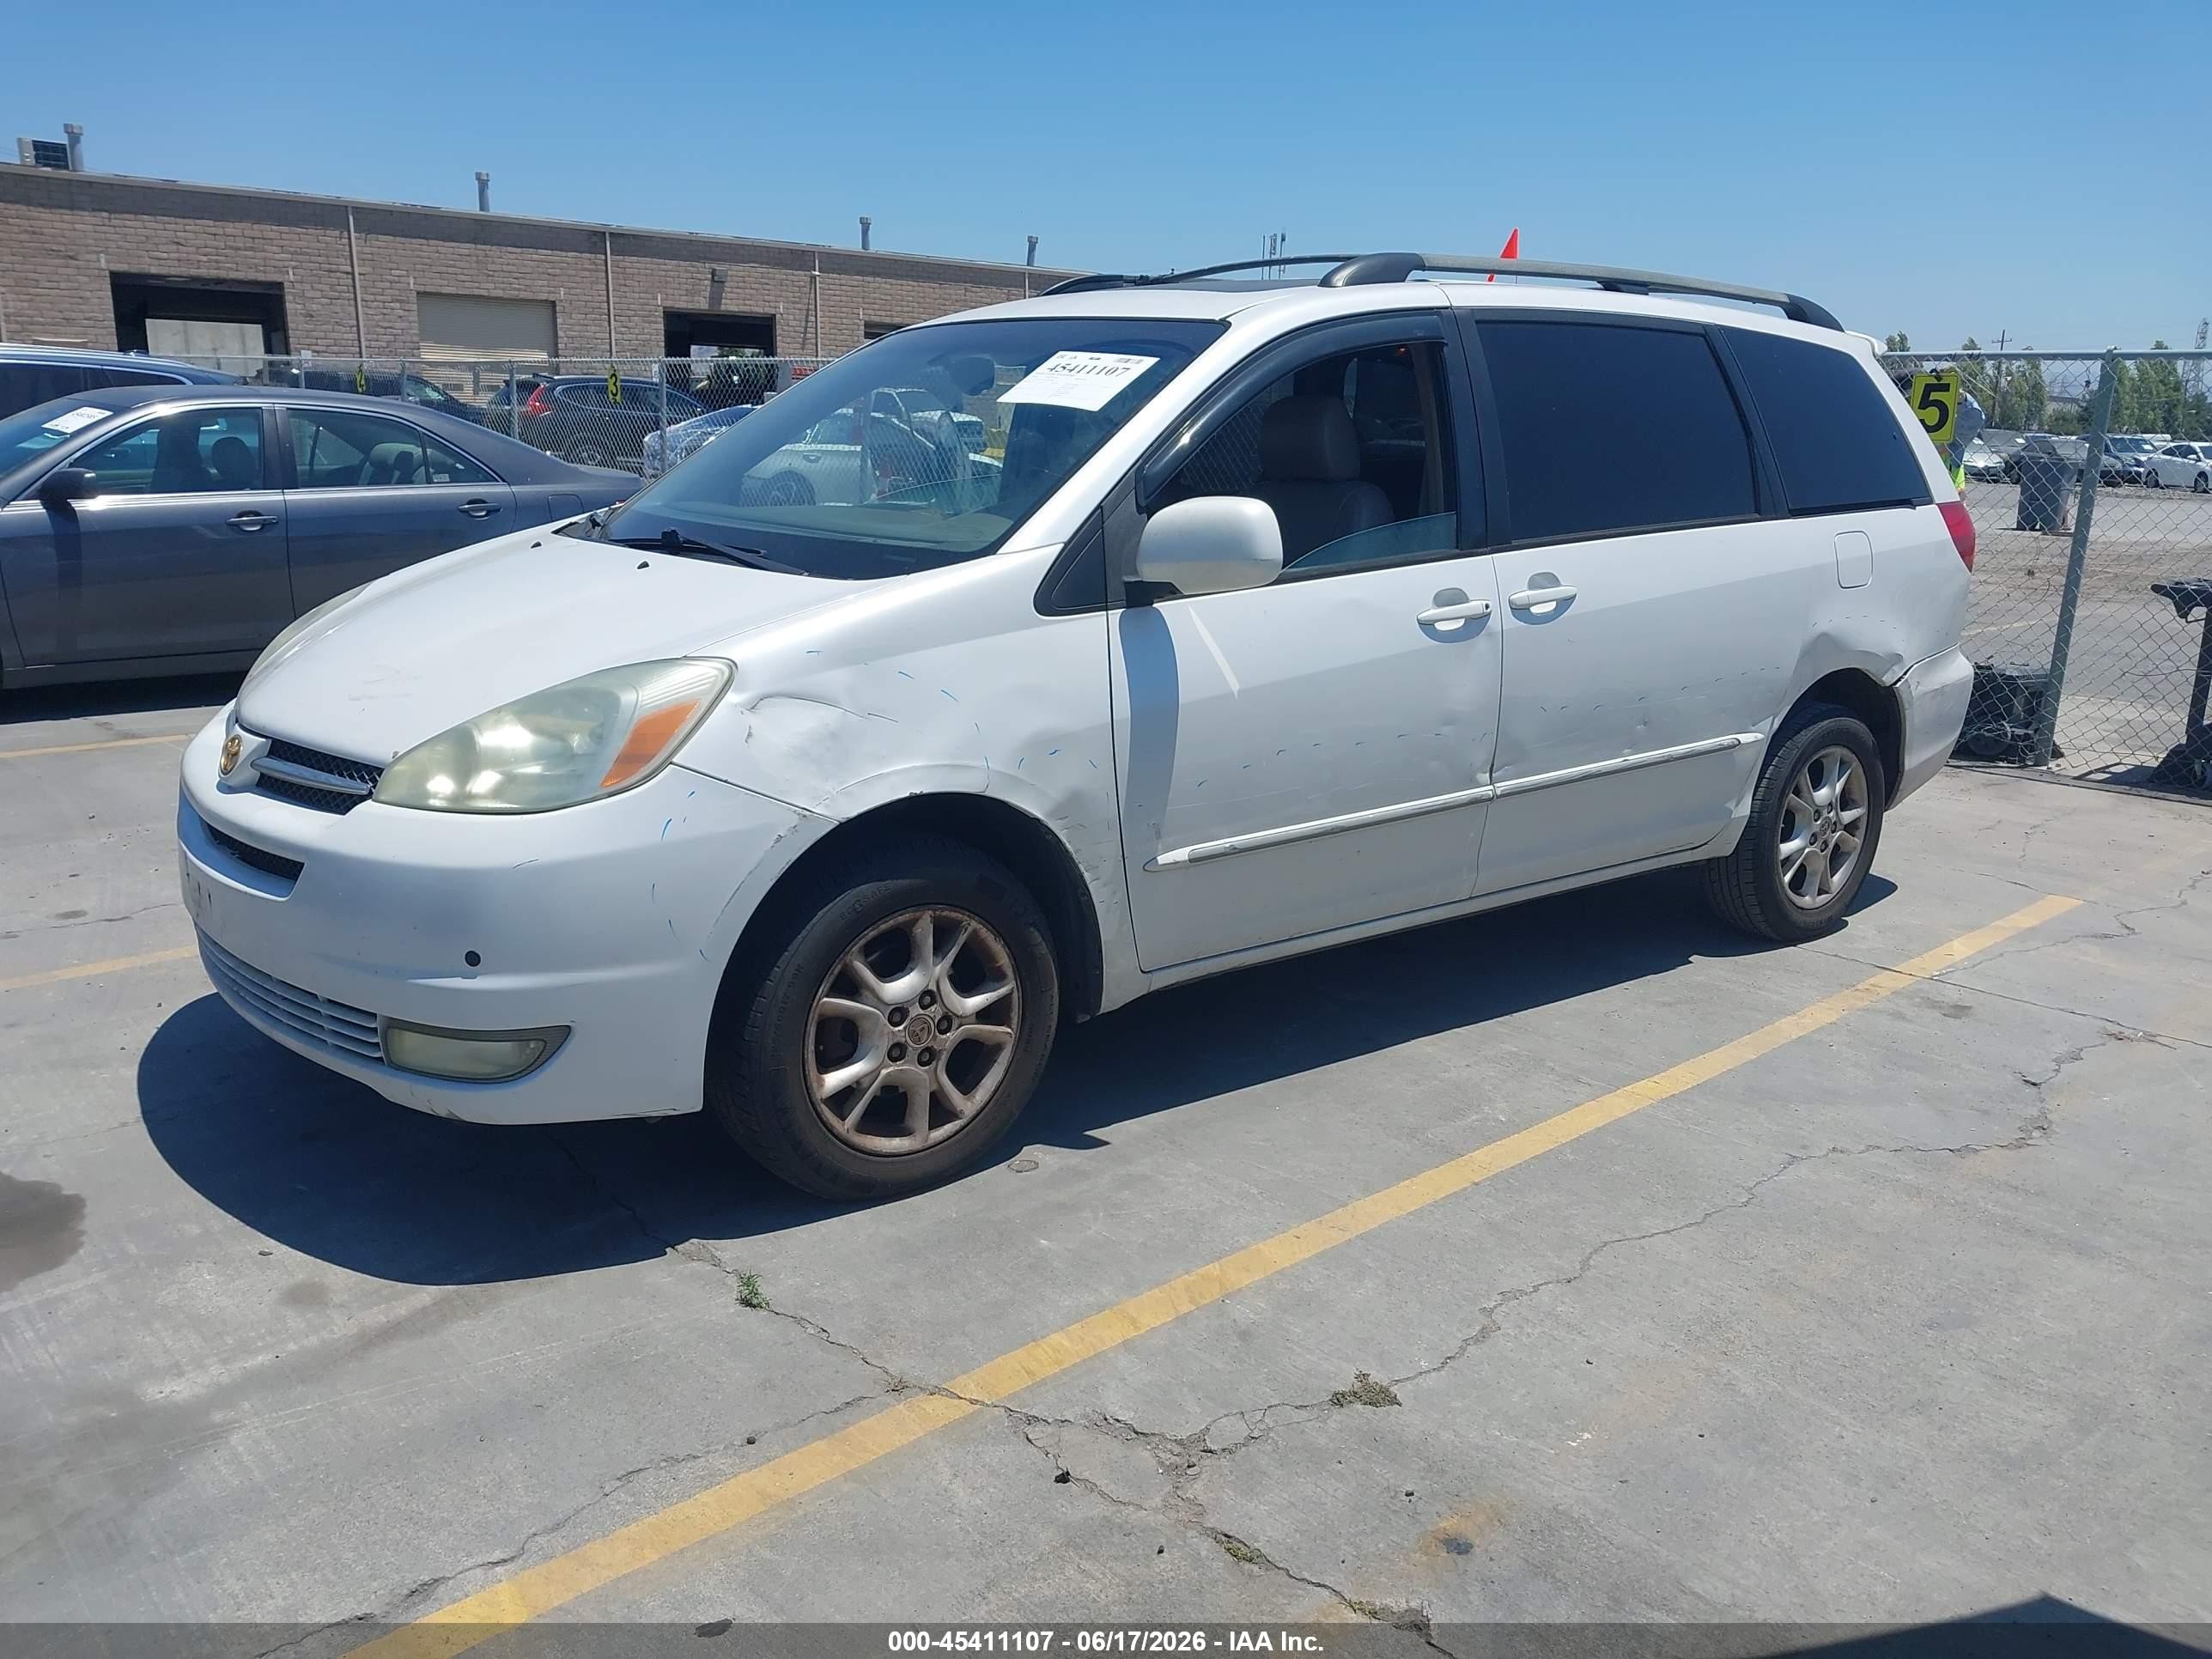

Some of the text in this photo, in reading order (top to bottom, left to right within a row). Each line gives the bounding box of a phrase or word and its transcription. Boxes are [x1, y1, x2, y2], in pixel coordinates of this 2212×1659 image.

[1047, 363, 1131, 377] 45411107
[610, 373, 618, 397] 3
[1917, 383, 1951, 434] 5
